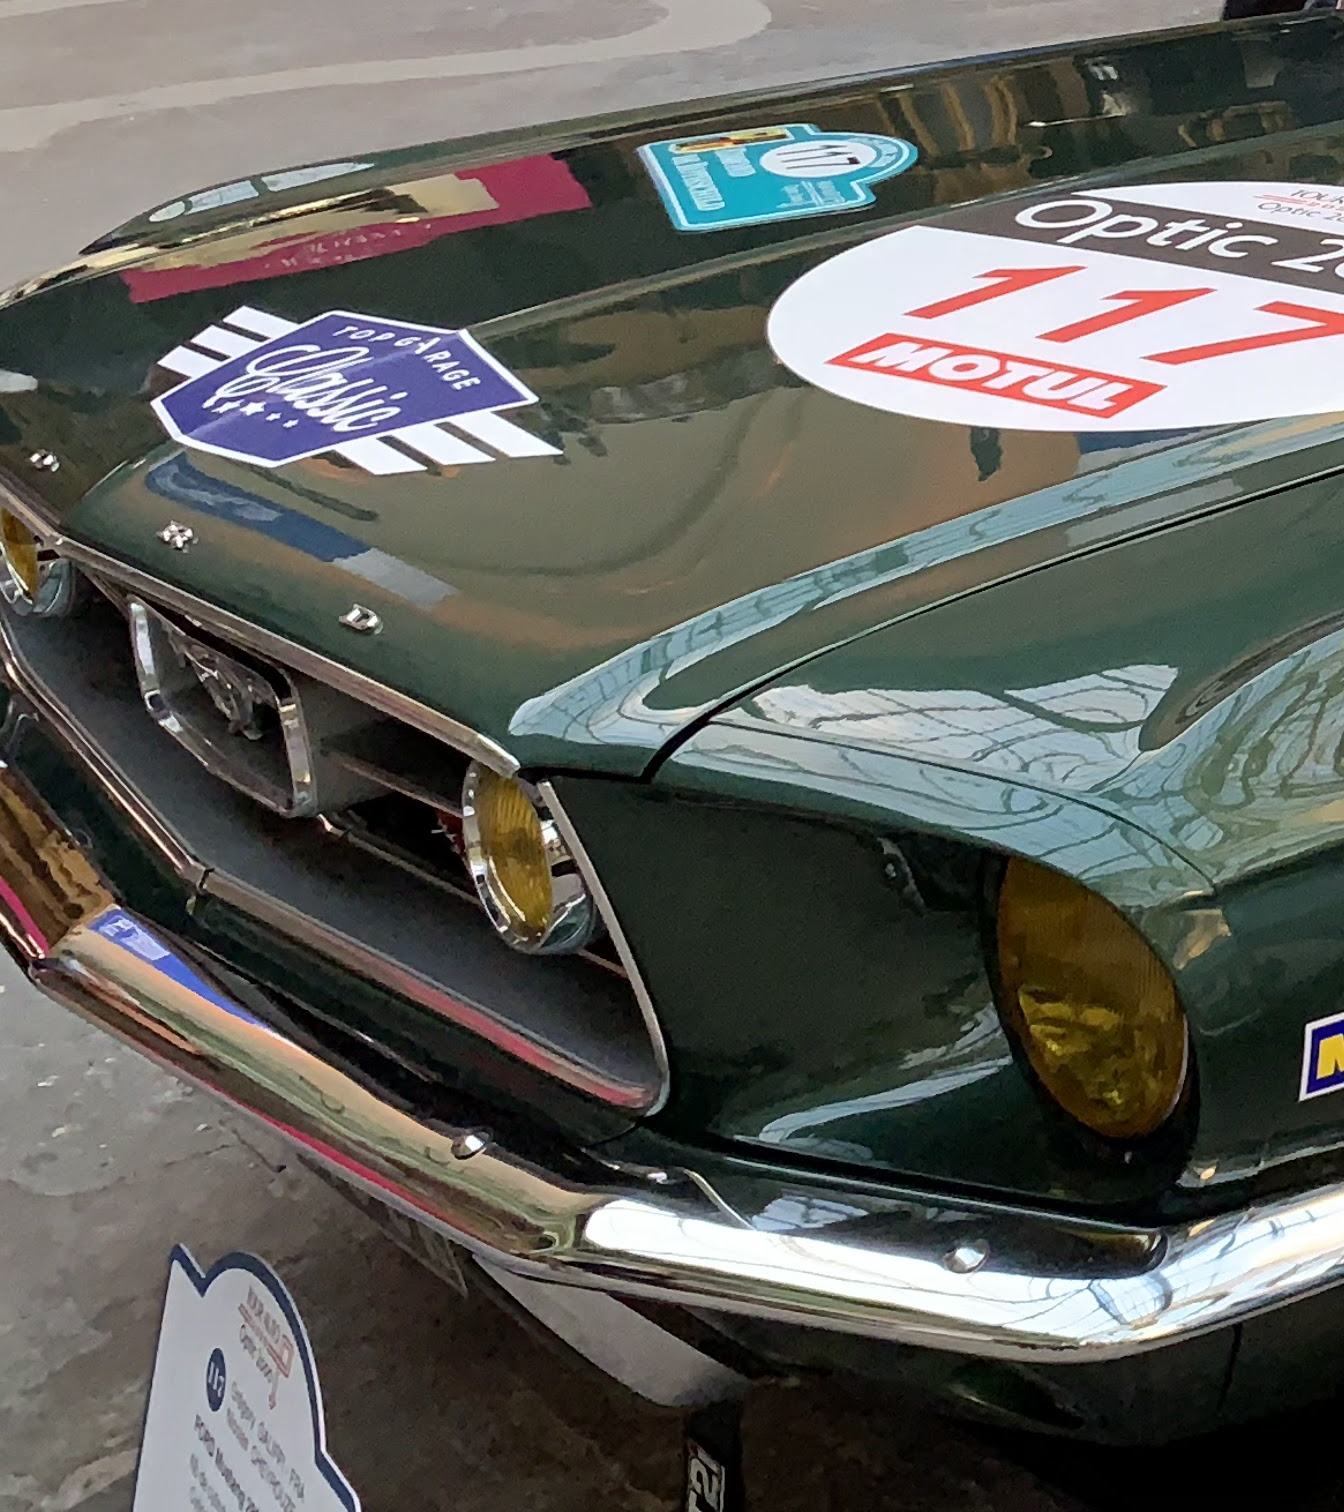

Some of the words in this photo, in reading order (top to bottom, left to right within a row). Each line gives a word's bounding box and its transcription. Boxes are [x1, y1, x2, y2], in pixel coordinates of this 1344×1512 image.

[1014, 199, 1263, 257] Optic
[1258, 202, 1321, 217] Optic
[203, 343, 409, 433] Classic
[333, 325, 389, 343] TOP
[395, 336, 481, 392] GARAGE
[848, 340, 1138, 412] MOTUL
